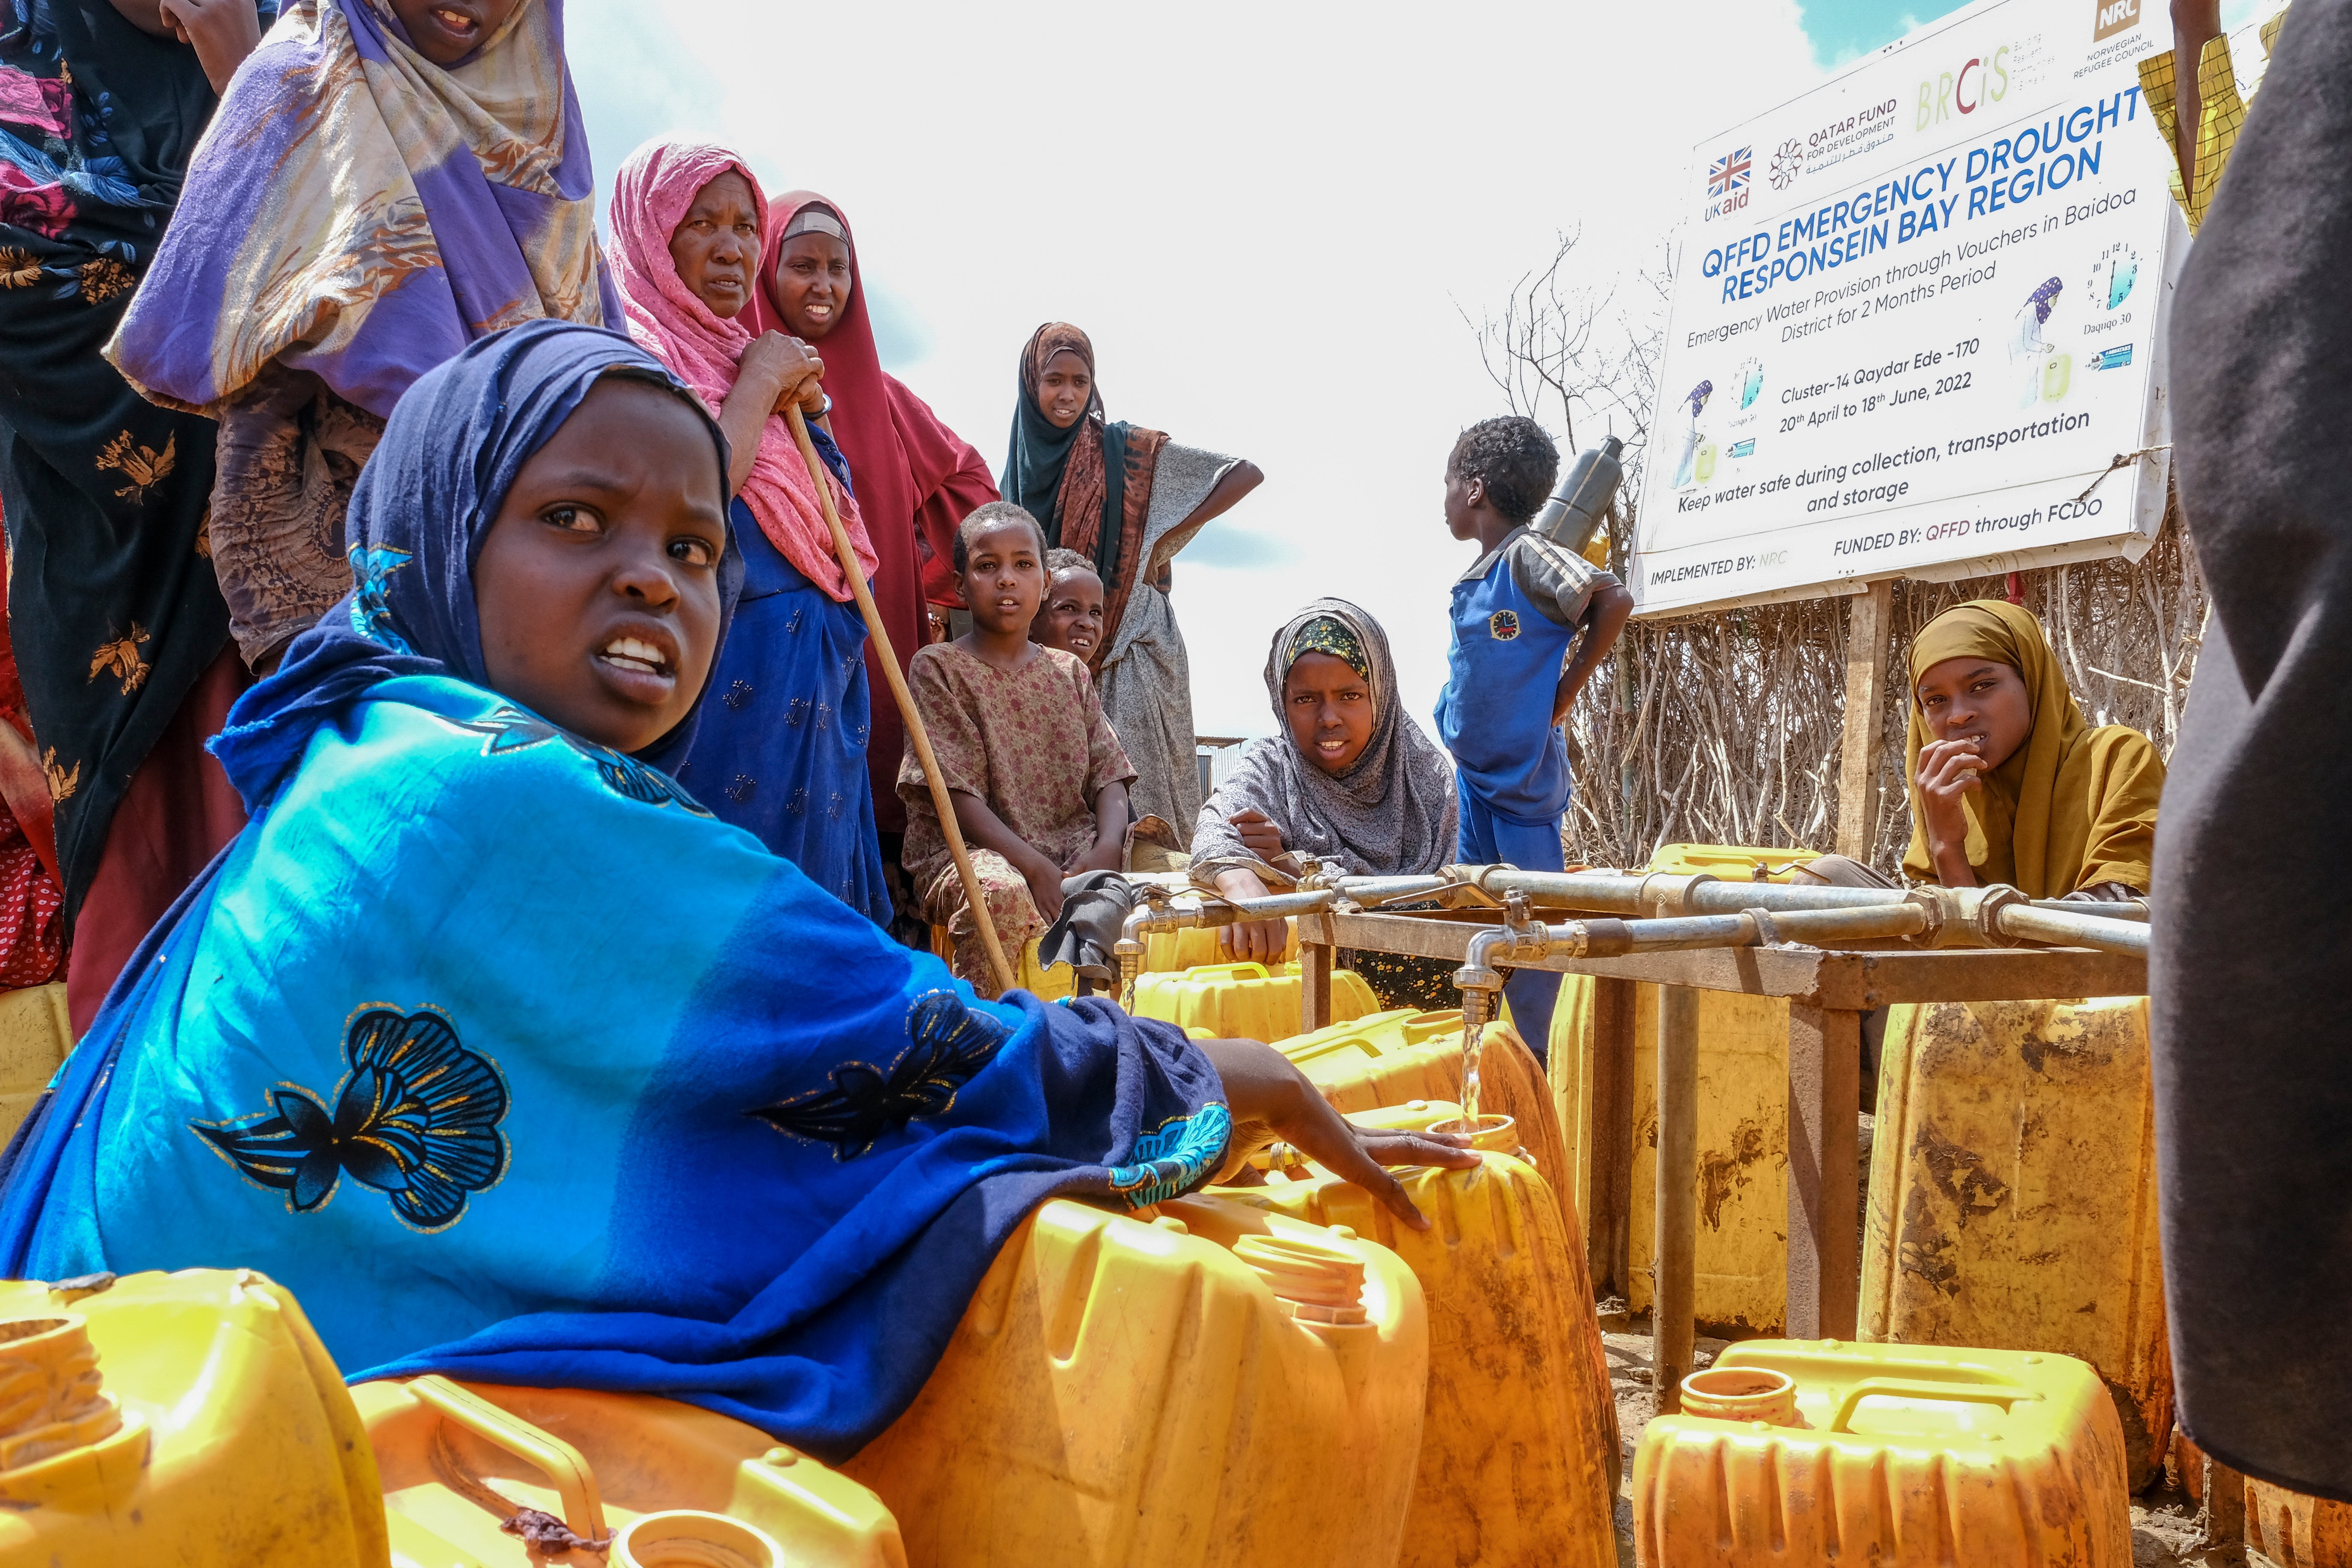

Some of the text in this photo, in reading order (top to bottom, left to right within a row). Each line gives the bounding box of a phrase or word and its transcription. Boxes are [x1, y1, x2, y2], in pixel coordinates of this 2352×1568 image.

[2099, 0, 2137, 30] NRC
[2074, 57, 2112, 79] REFUGEE
[2115, 40, 2154, 62] COUNCIL
[2088, 33, 2141, 61] NORWEGIAN
[1807, 116, 1895, 161] FOR DEVELOPMENT
[1809, 99, 1896, 147] QATAR FUND
[1703, 85, 2141, 278] QFFD EMERGENCY DROUGHT
[1722, 141, 2102, 304] RESPONSEIN BAY REGION
[2102, 250, 2109, 260] 11
[2112, 242, 2120, 252] 12
[2131, 251, 2136, 259] 2
[1688, 189, 2136, 348] Emergency Water Provision through Vouchers in Baidoa
[2132, 264, 2137, 274] 3
[1782, 260, 1995, 342] District for 2 Months Period
[2120, 312, 2132, 325] 30
[1782, 338, 1979, 404] Cluster-14 Qaydar Ede -170
[1779, 414, 1804, 433] 20th
[1807, 404, 1839, 428] April
[1843, 405, 1857, 417] to
[1863, 393, 1885, 413] 18th
[1889, 387, 1929, 406] June,
[1935, 372, 1971, 395] 2022
[1678, 413, 2089, 513] Keep water safe during collection, transportation
[1807, 482, 1908, 512] and storage
[1834, 499, 2102, 556] FUNDED BY: QFFD through FCDO
[1651, 550, 1788, 585] IMPLEMENTED BY: NRC
